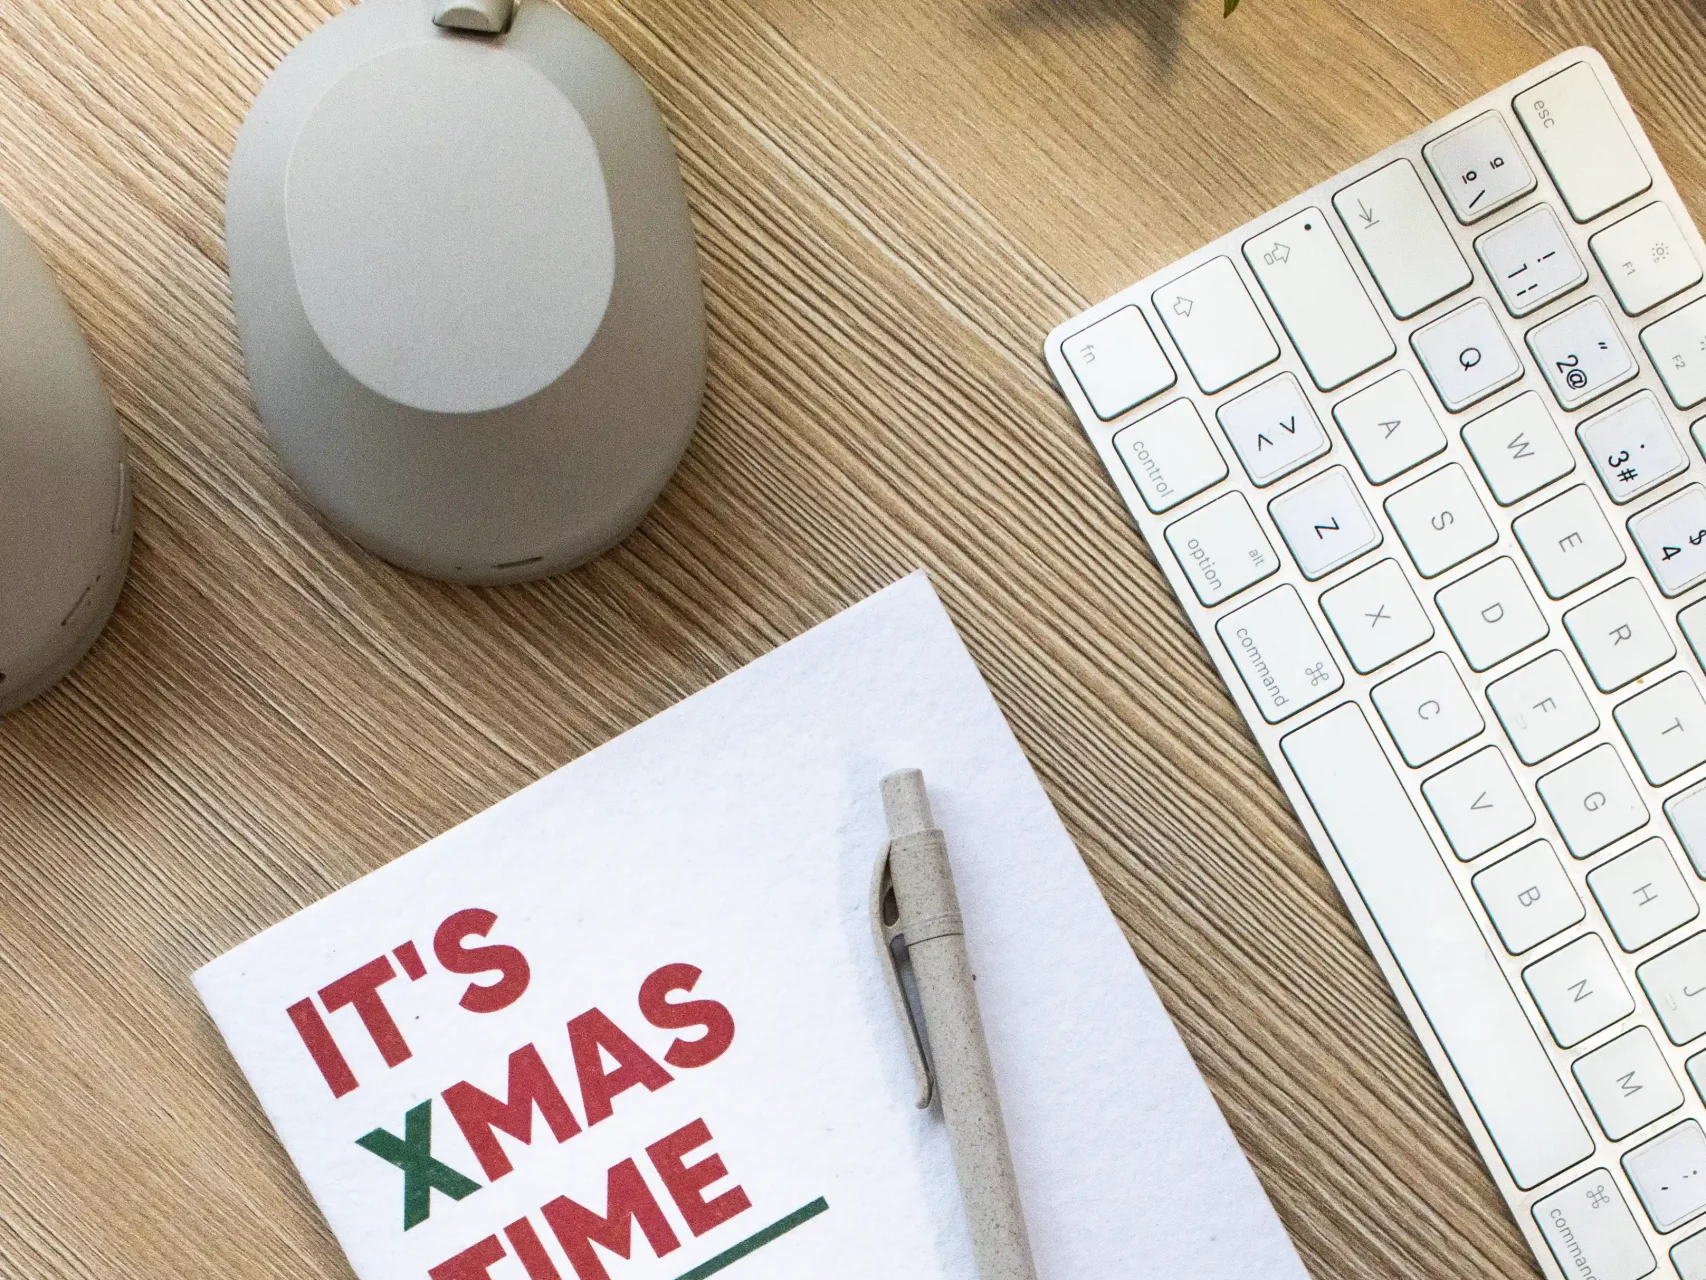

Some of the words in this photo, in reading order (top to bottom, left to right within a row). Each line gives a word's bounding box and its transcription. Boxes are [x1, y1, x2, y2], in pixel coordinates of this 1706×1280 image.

[1533, 99, 1555, 130] esc
[1622, 261, 1636, 276] F1
[1079, 344, 1096, 364] fn
[1459, 348, 1481, 371] Q
[1671, 353, 1686, 370] F2
[1378, 420, 1402, 440] A
[1507, 432, 1534, 459] W
[1132, 440, 1174, 499] control
[1314, 517, 1339, 539] Z
[1431, 511, 1454, 530] S
[1559, 532, 1582, 552] E
[1248, 548, 1265, 567] alt
[1662, 547, 1681, 561] 4
[1187, 538, 1223, 592] option
[1365, 604, 1391, 628] X
[1481, 603, 1504, 623] D
[1609, 624, 1631, 645] R
[1235, 626, 1290, 708] command
[1418, 700, 1440, 720] C
[1532, 697, 1557, 713] F
[1662, 718, 1684, 734] T
[1470, 792, 1493, 810] V
[1584, 792, 1606, 811] G
[1518, 886, 1541, 907] B
[1633, 883, 1658, 906] H
[1568, 979, 1593, 1002] N
[1684, 987, 1706, 997] J
[286, 907, 531, 1099] IT'S
[1616, 1071, 1643, 1097] M
[354, 962, 736, 1231] XMAS
